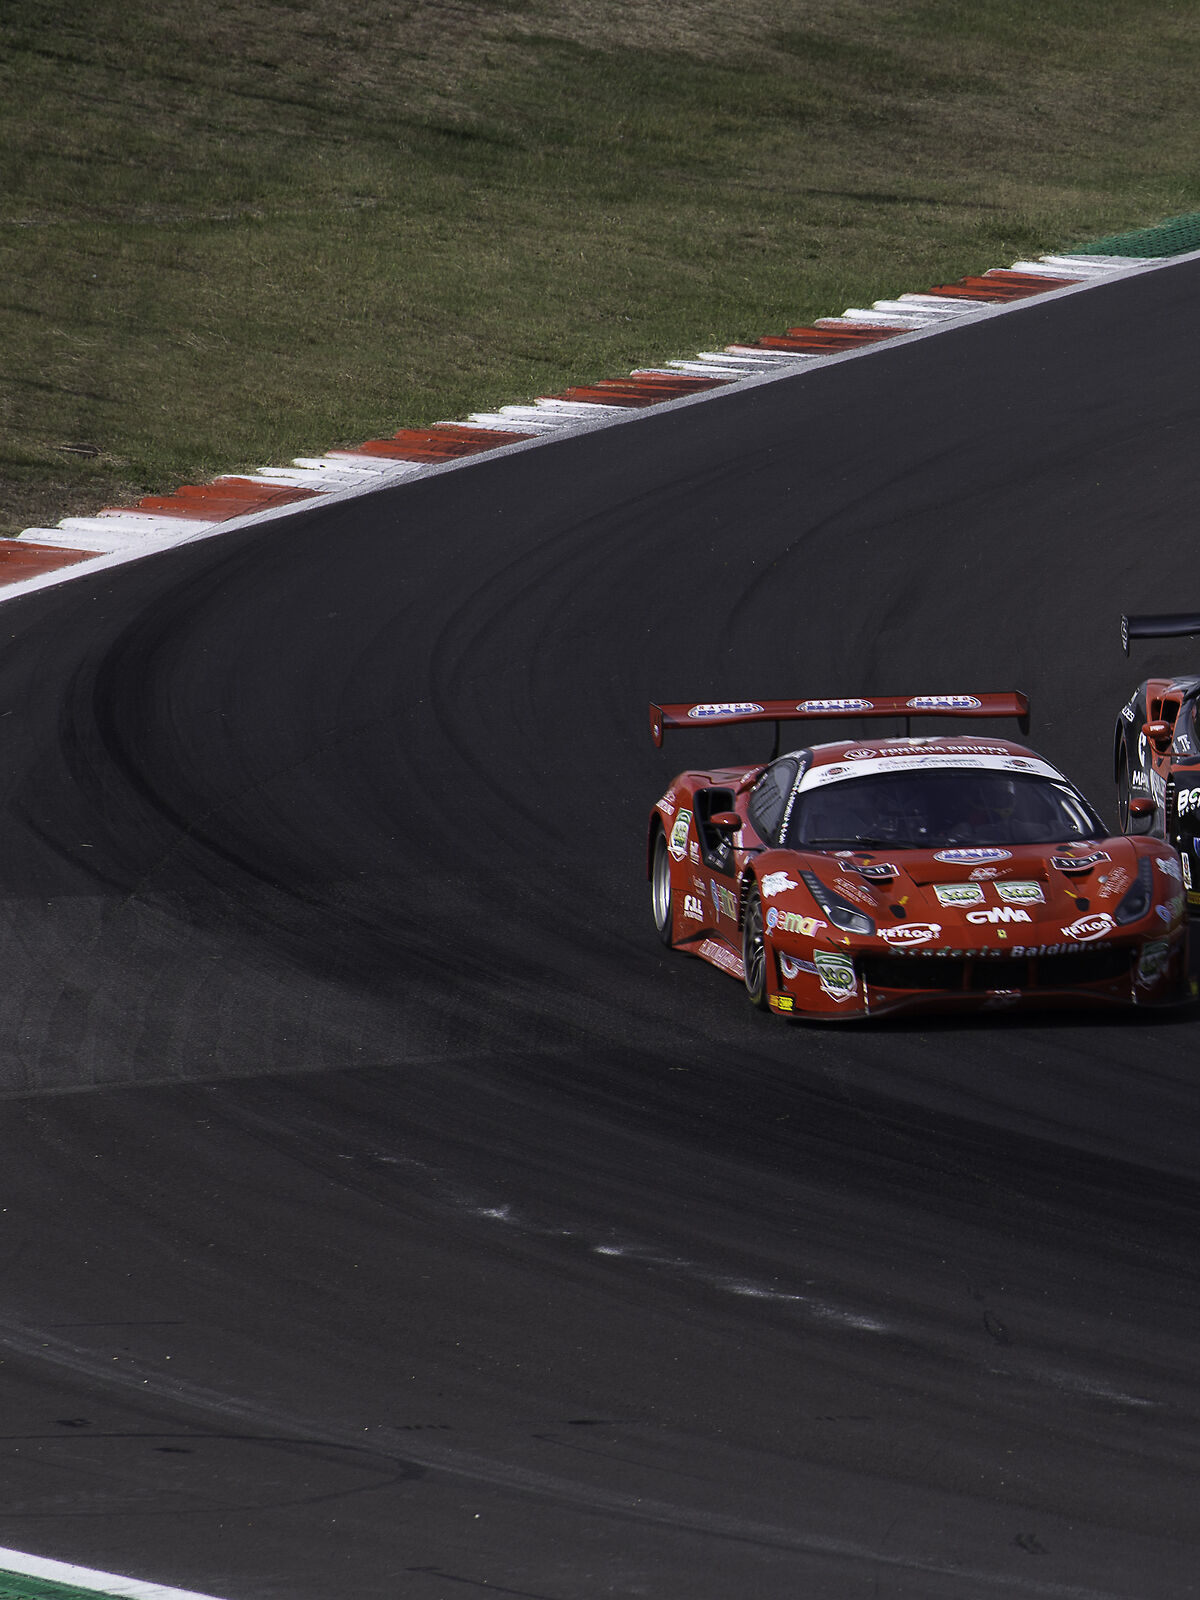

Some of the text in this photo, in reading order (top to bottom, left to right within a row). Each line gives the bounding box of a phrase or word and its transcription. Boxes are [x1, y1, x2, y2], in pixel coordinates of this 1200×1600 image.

[766, 907, 829, 938] Gemar
[965, 906, 1033, 925] CMA
[1010, 942, 1086, 958] Baldini
